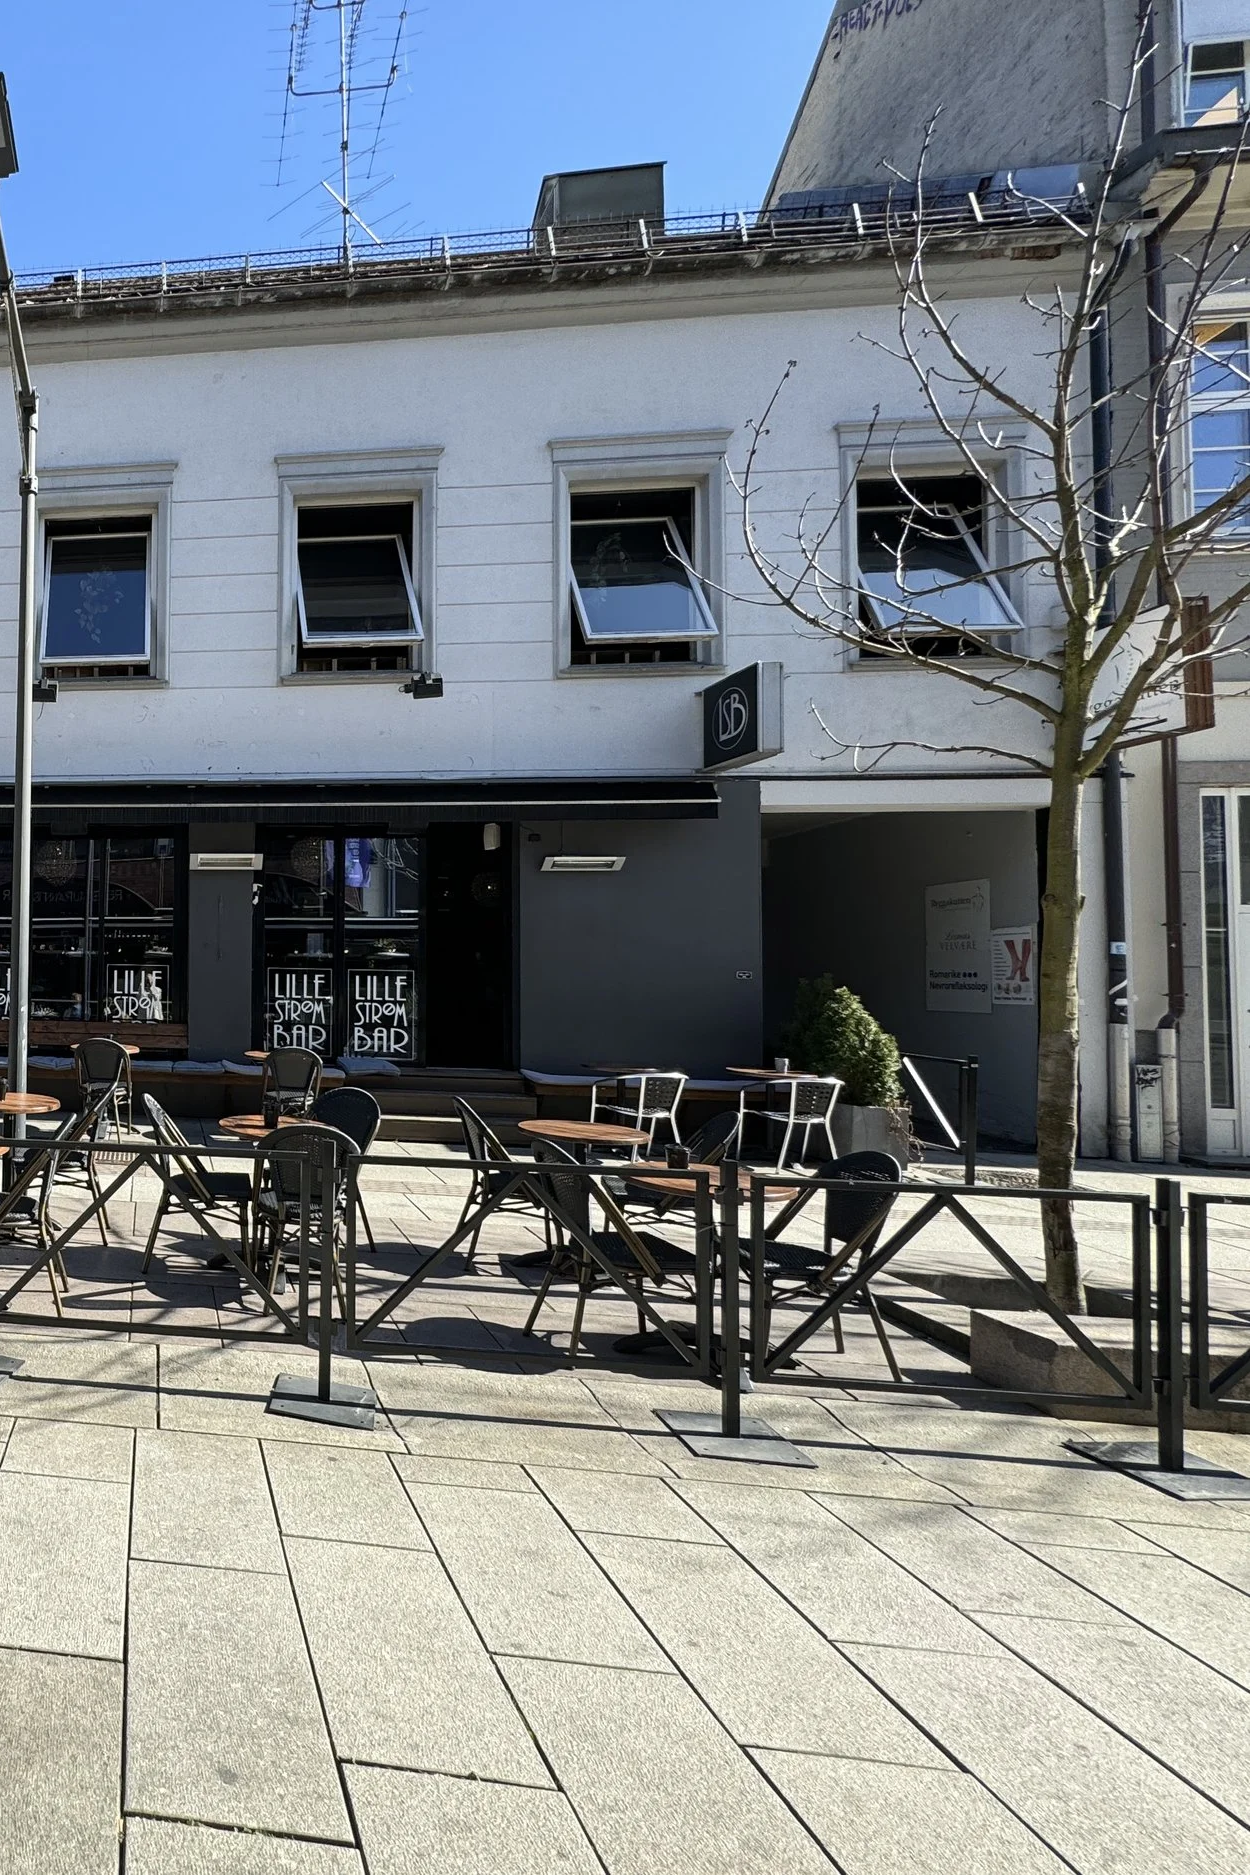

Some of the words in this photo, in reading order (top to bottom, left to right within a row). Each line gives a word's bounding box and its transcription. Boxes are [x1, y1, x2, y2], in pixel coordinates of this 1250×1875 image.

[274, 973, 326, 999] LILLE
[355, 975, 408, 1001] LILLE
[273, 1000, 326, 1025] STRØM
[354, 1002, 408, 1027] STRØM
[273, 1024, 327, 1050] BAR
[354, 1026, 409, 1053] BAR
